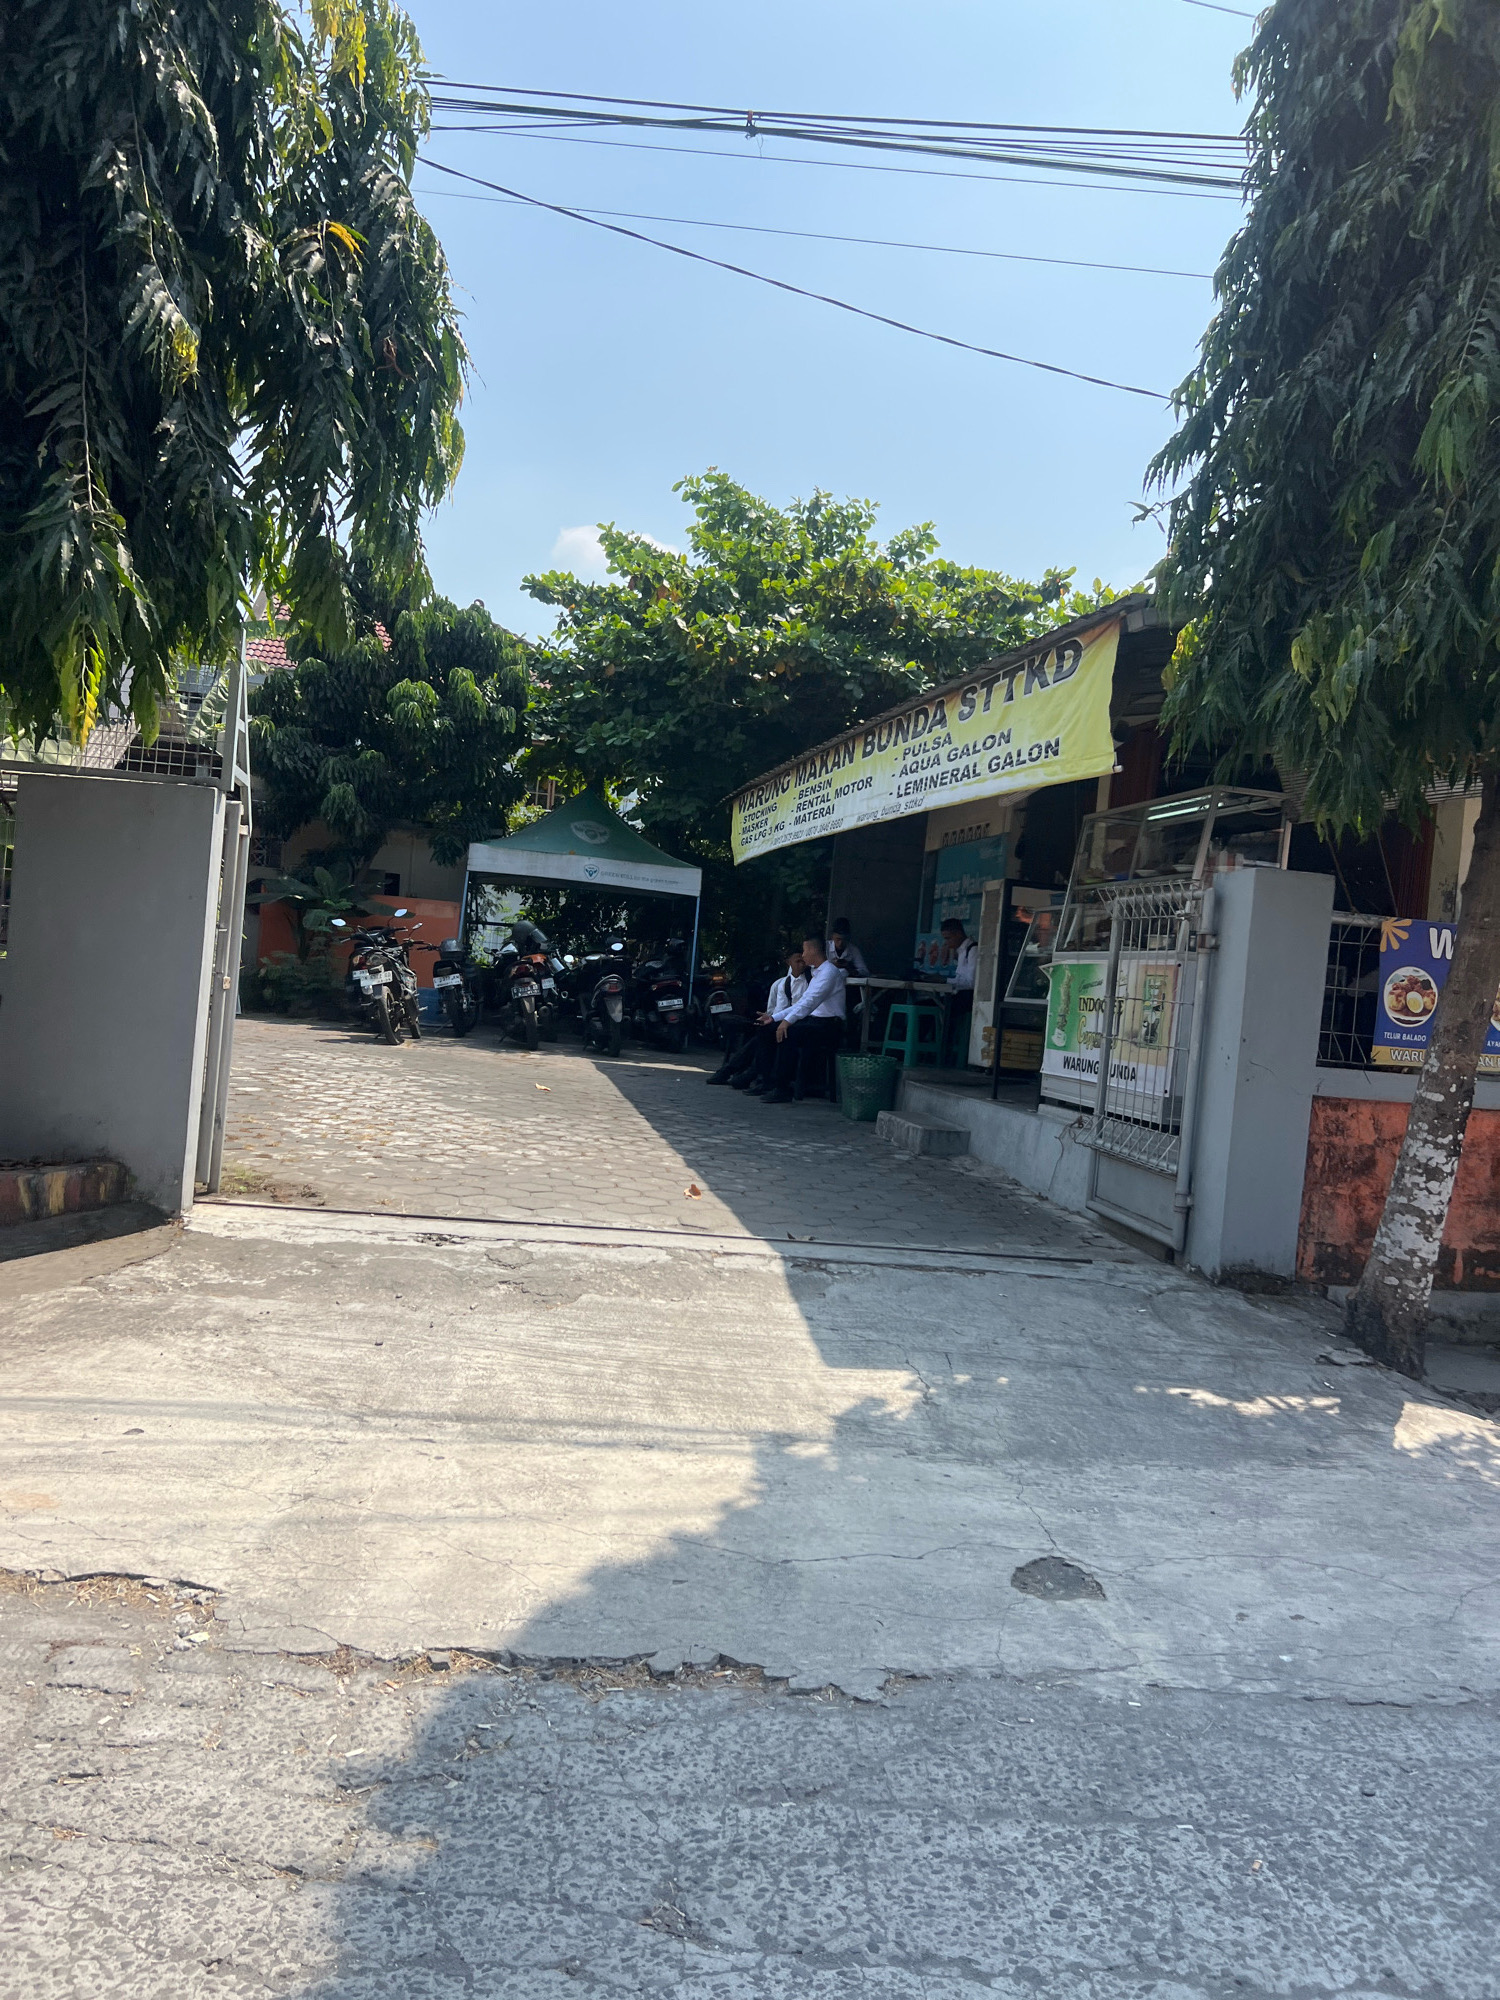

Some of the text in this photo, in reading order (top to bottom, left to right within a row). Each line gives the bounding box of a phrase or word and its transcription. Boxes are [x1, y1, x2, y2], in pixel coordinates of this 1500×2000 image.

[739, 639, 1083, 814] WARUNG MAKAN BUNDA STTKD
[899, 728, 1012, 778] AQUA GALON
[903, 732, 952, 761] PULSA
[896, 737, 1060, 799] LEMINERAL GALON
[796, 776, 873, 813] RENTAL MOTOR
[798, 778, 833, 800] BENSIN
[743, 802, 778, 824] STOCKING
[793, 804, 835, 825] MATERAI
[741, 836, 753, 846] GAS
[754, 829, 767, 842] LPG
[768, 827, 773, 836] 3
[774, 821, 785, 834] KG
[742, 818, 769, 835] MASKER
[1384, 1031, 1427, 1042] TELUR BALADO
[1063, 1055, 1136, 1081] WARUNG UNDA
